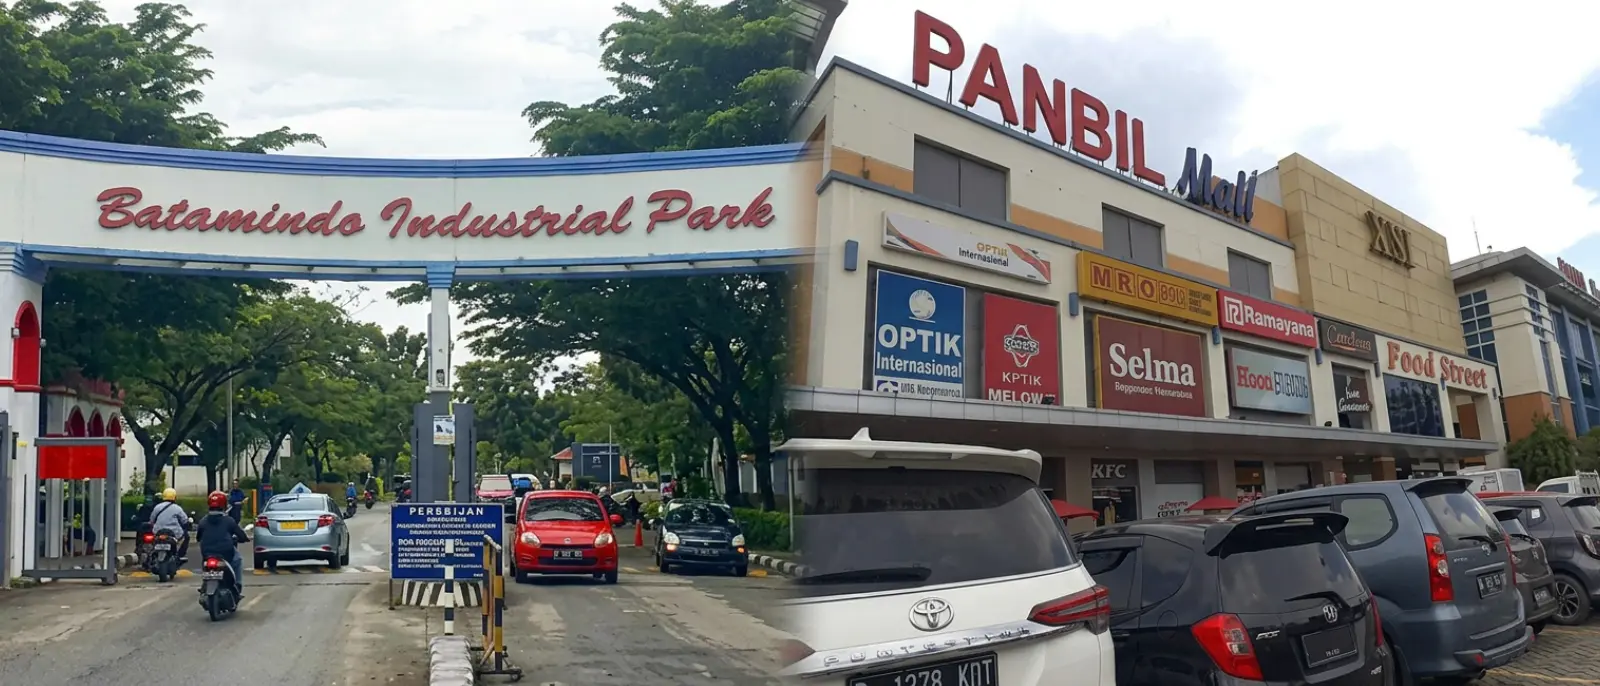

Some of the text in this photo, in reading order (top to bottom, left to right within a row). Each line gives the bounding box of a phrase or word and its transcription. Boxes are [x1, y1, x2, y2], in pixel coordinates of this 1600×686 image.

[912, 10, 1257, 223] PANBIL Mall
[97, 187, 776, 239] Batamindo Industrial Park
[1243, 305, 1315, 339] Ramayana
[878, 323, 961, 358] OPTIK
[876, 351, 962, 379] Internasional
[1002, 371, 1043, 387] KPTIK
[1109, 342, 1196, 387] Selma
[1386, 341, 1488, 389] Food Street
[1091, 463, 1126, 479] KFC
